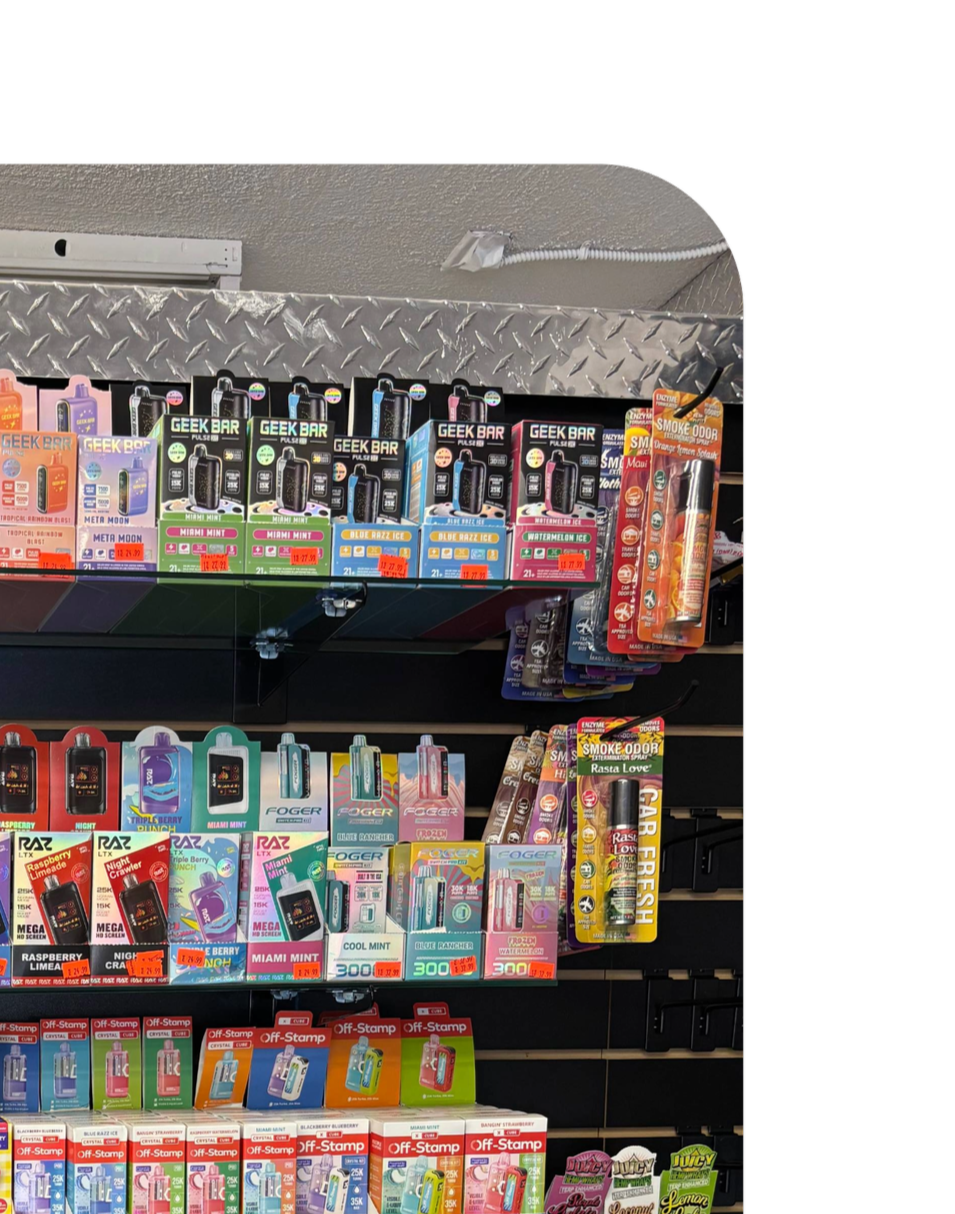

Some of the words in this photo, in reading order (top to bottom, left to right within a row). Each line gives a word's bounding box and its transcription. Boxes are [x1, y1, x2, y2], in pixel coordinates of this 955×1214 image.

[171, 418, 208, 433] GEEK
[211, 418, 239, 434] BAR
[530, 424, 565, 439] GEEK
[568, 425, 595, 440] BAR
[2, 434, 41, 449] GEEK
[43, 435, 71, 450] BAR
[93, 534, 115, 543] META
[118, 534, 142, 543] MOON
[528, 533, 573, 543] WATERMELON
[576, 534, 587, 543] ICE
[583, 744, 623, 755] SMOKE
[625, 743, 659, 754] ODOR
[591, 763, 619, 773] Rasta
[623, 763, 650, 773] Love
[266, 807, 322, 815] FOGER
[640, 788, 659, 836] CAR
[26, 850, 71, 873] Raspberry
[30, 861, 67, 881] Limeade
[635, 846, 656, 925] FRESH
[369, 942, 390, 950] MINT
[22, 954, 82, 962] RASPBERRY
[252, 954, 287, 962] MIAMI
[290, 954, 319, 962] MINT
[260, 1032, 325, 1045] Off-Stamp
[388, 1142, 460, 1154] Off-Stamp
[613, 1159, 655, 1176] JUICY
